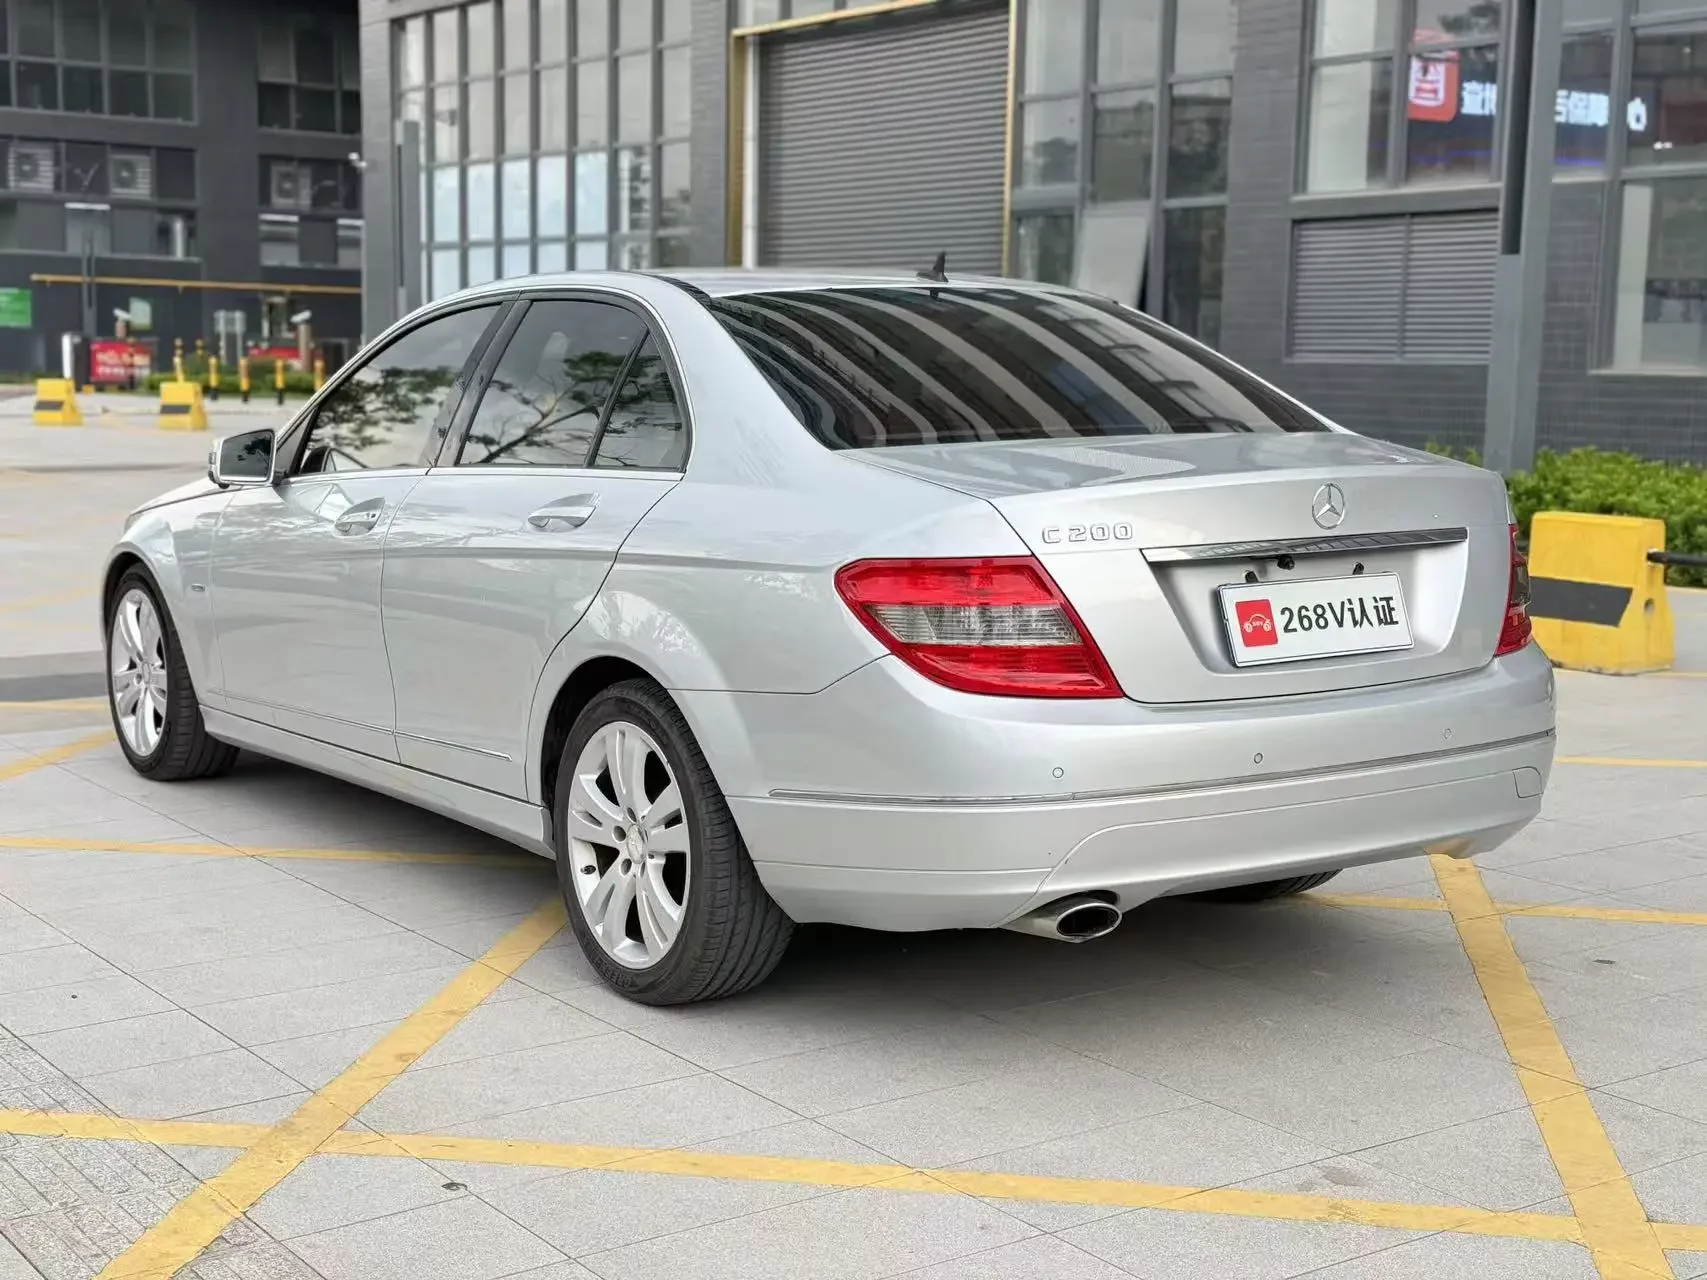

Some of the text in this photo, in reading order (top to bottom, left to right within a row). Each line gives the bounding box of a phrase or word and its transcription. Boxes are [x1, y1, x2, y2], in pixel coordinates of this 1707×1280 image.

[1042, 522, 1133, 544] C 200
[1280, 596, 1399, 634] 268V认证
